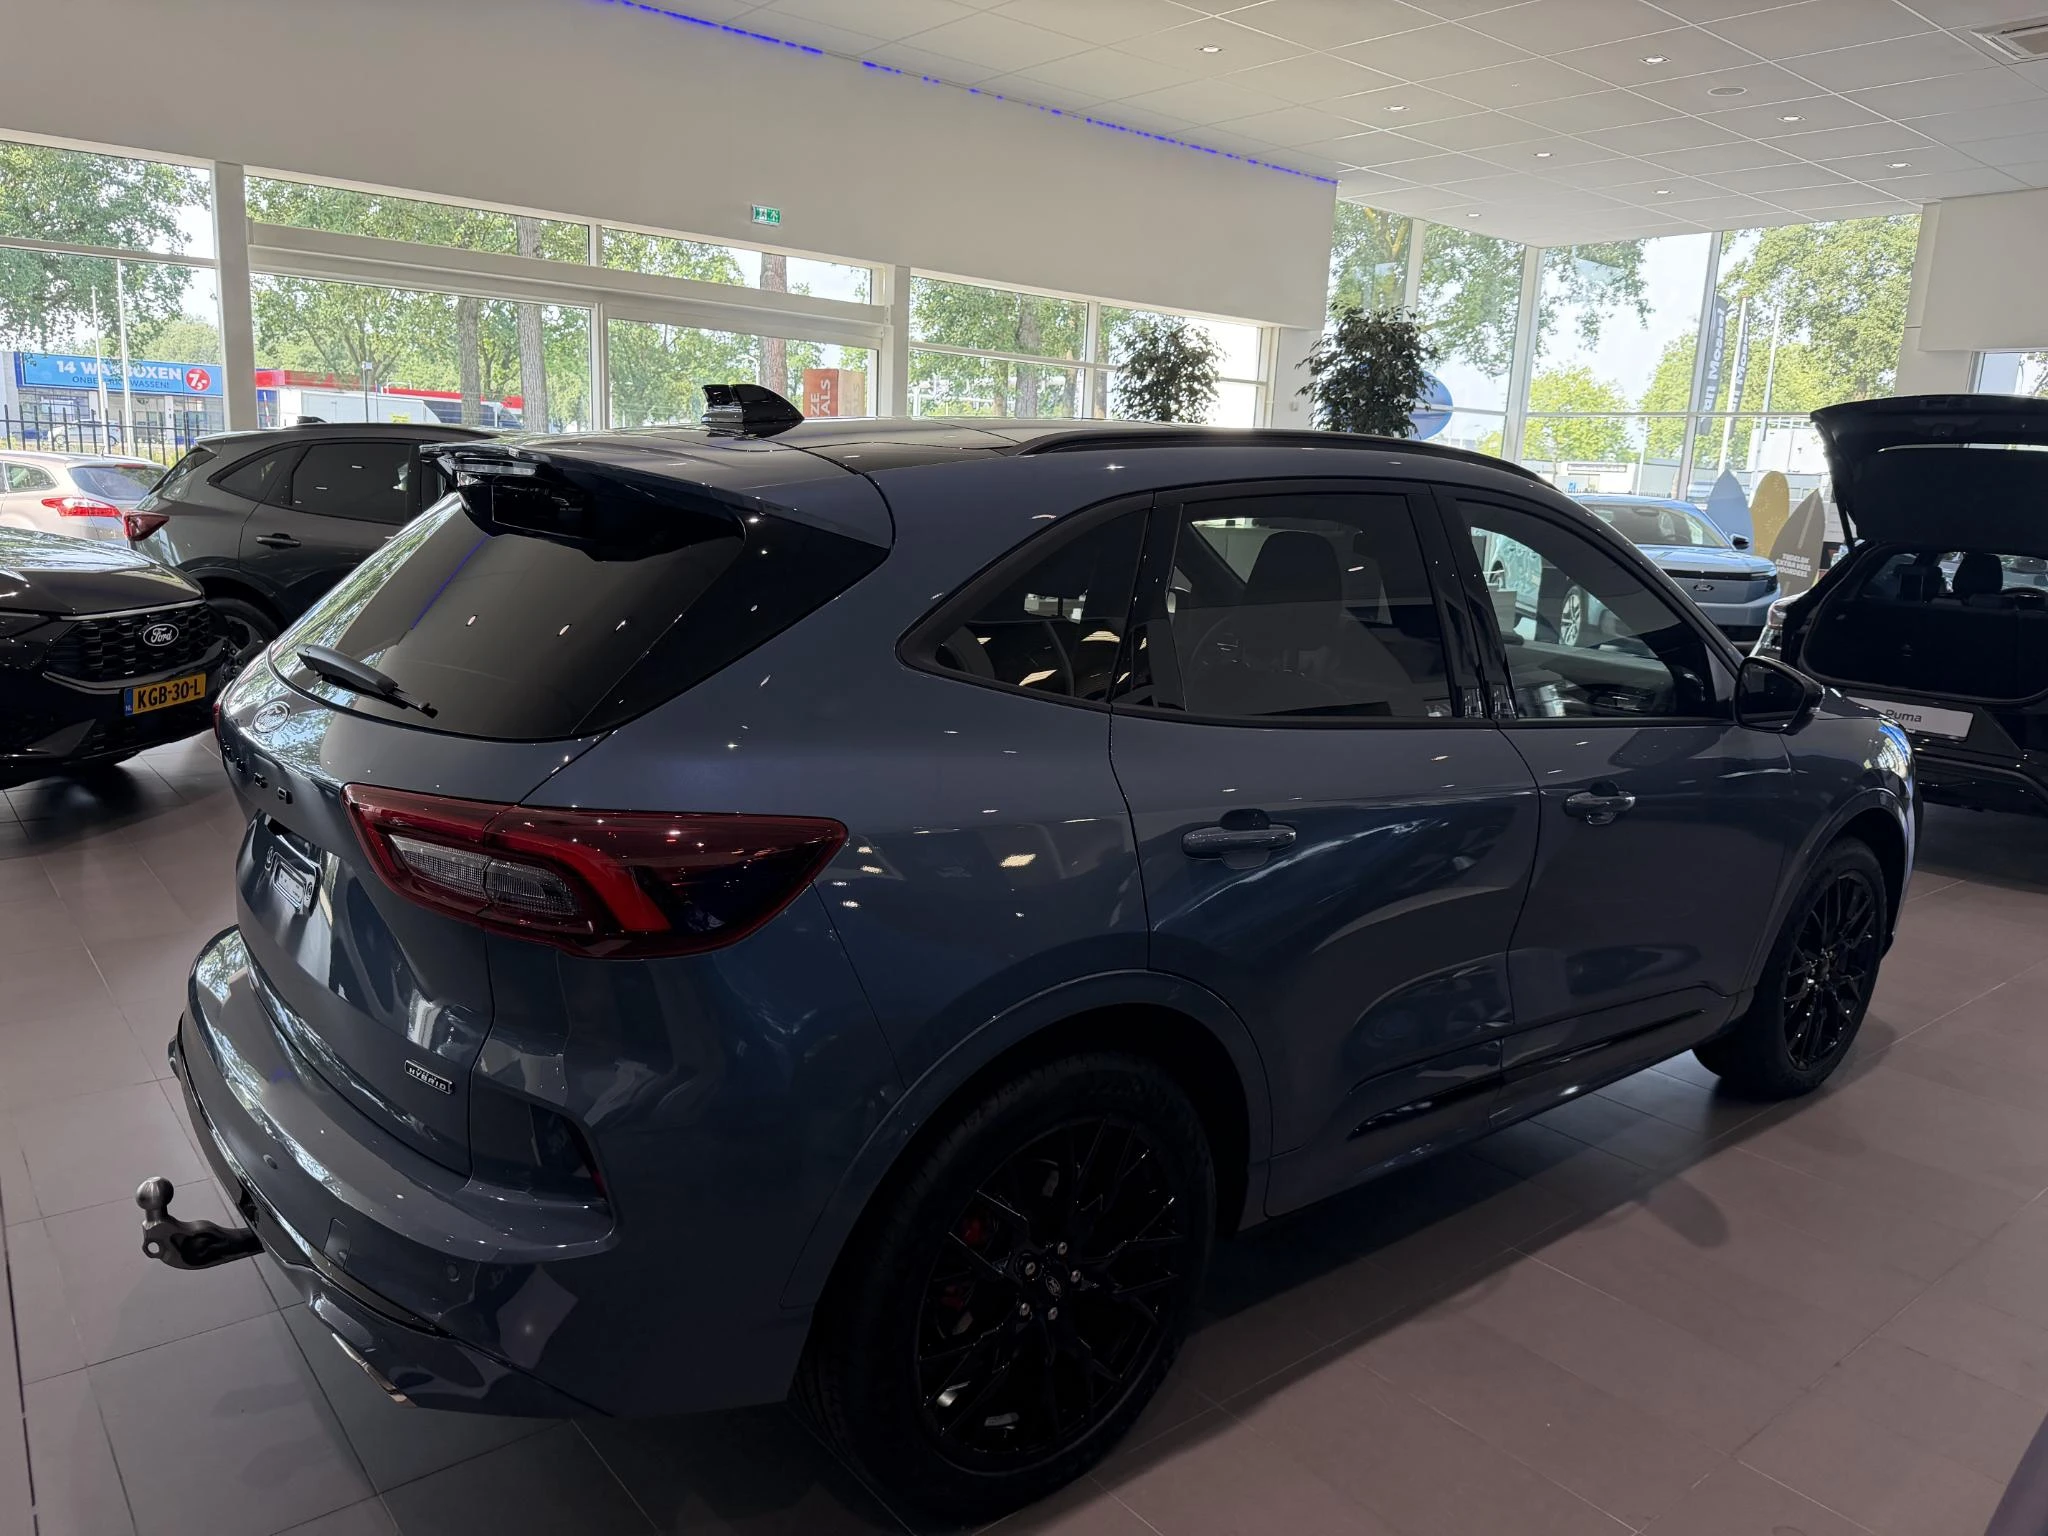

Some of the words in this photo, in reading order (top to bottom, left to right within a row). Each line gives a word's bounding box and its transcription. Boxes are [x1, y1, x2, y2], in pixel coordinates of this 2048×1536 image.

[56, 360, 76, 374] 14
[131, 379, 168, 389] WASSEN!
[150, 627, 173, 643] Ford
[137, 678, 201, 709] KGB-30-L
[1885, 708, 1922, 723] Puma
[409, 1067, 446, 1091] HYBRID
